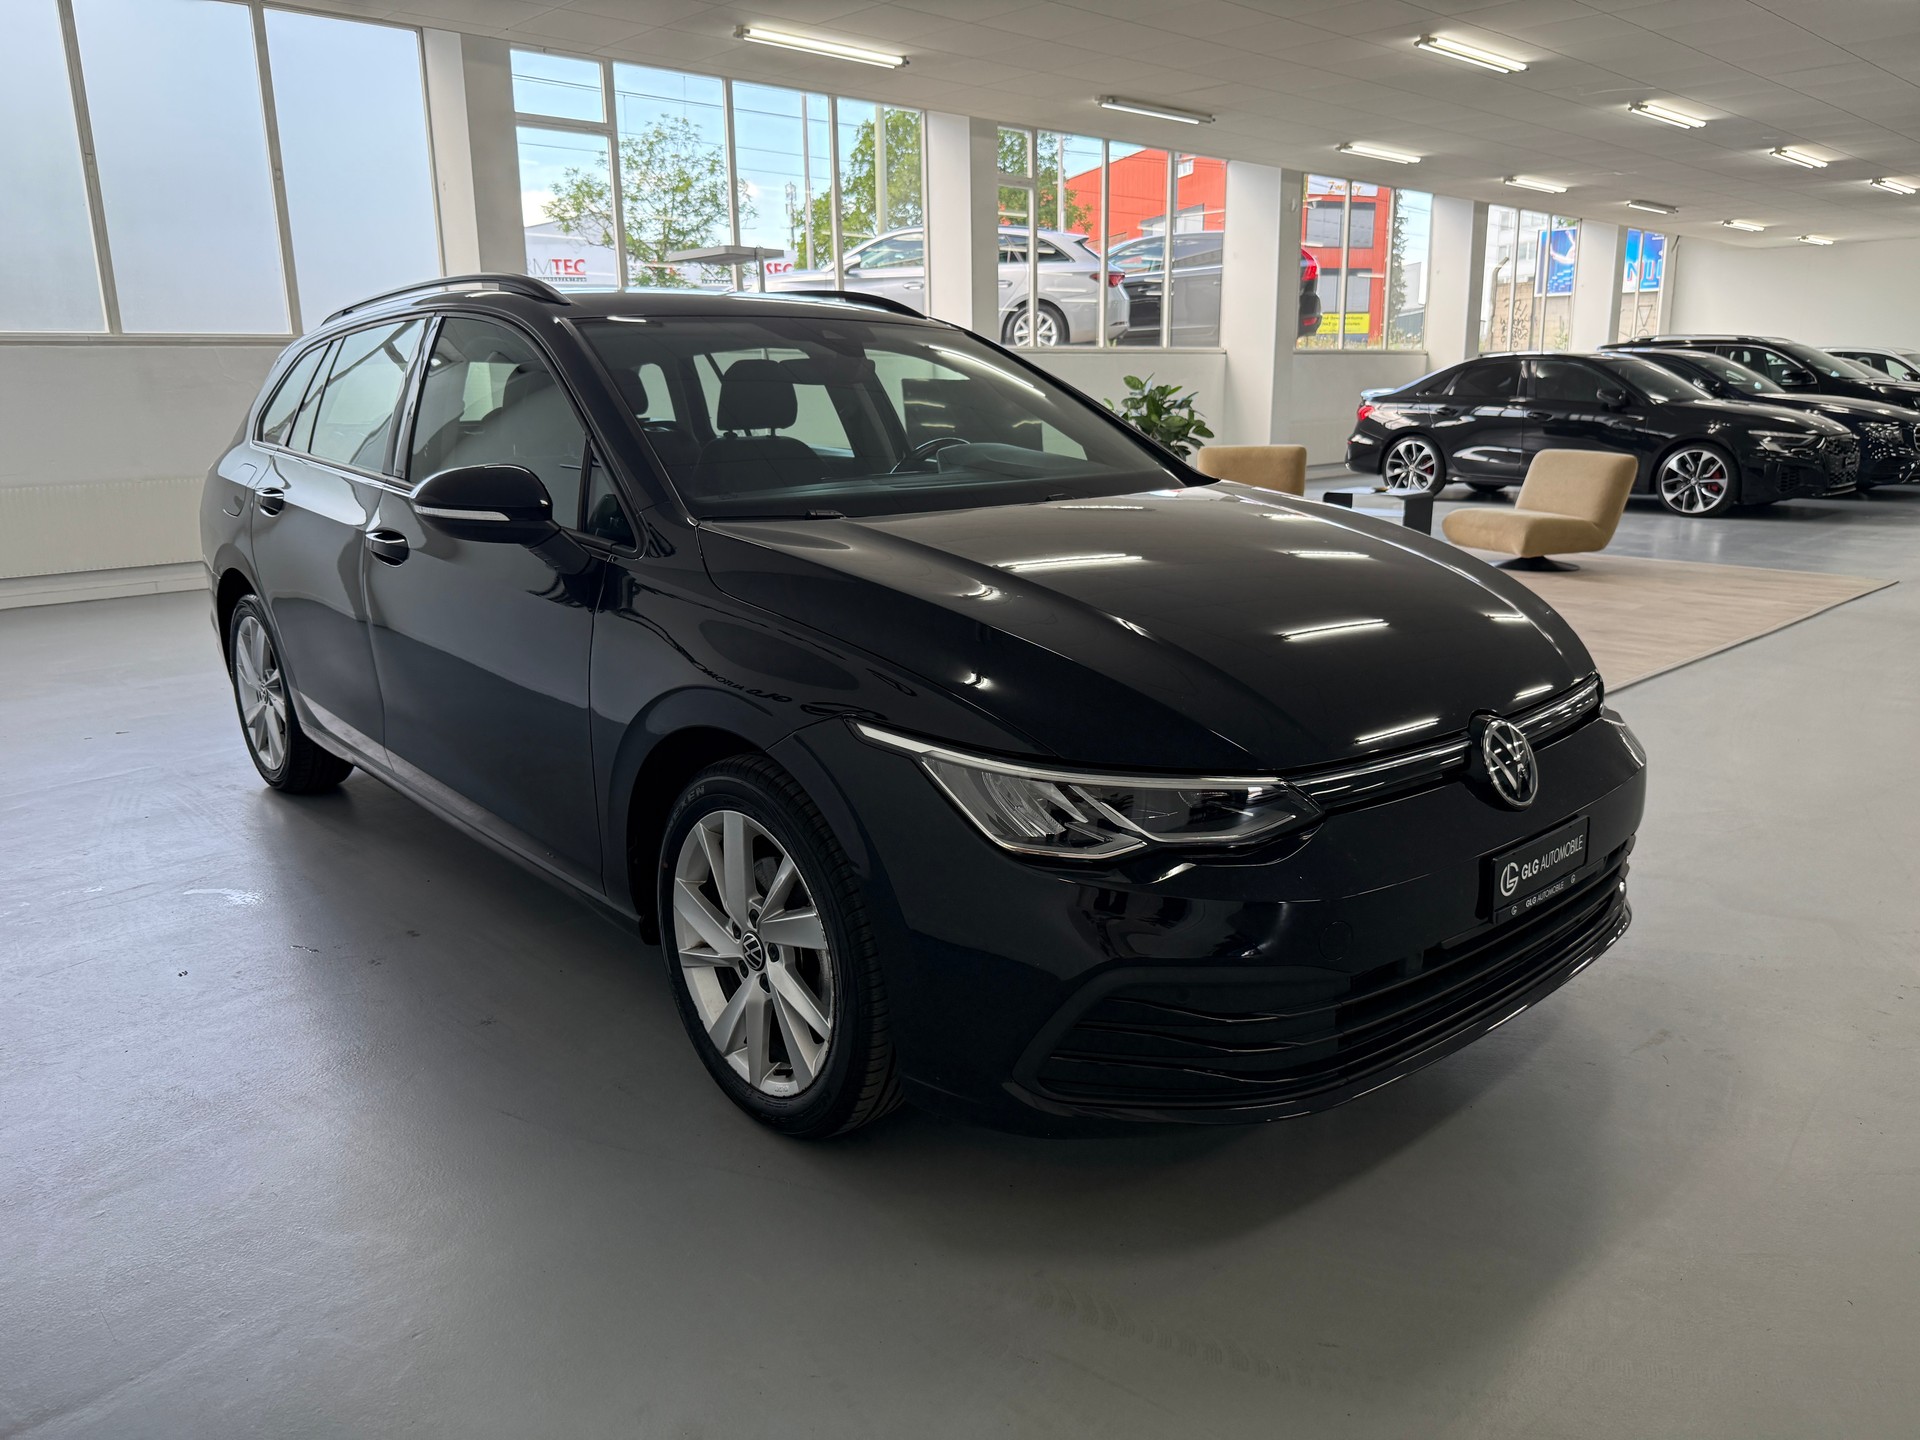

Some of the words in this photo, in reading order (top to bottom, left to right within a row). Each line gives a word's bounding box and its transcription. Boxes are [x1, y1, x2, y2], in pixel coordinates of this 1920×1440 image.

[1521, 859, 1540, 880] GLG
[1540, 834, 1583, 871] AUTOMOBILE
[1526, 896, 1537, 907] GLG
[1537, 881, 1564, 901] AUTOMOBILE
